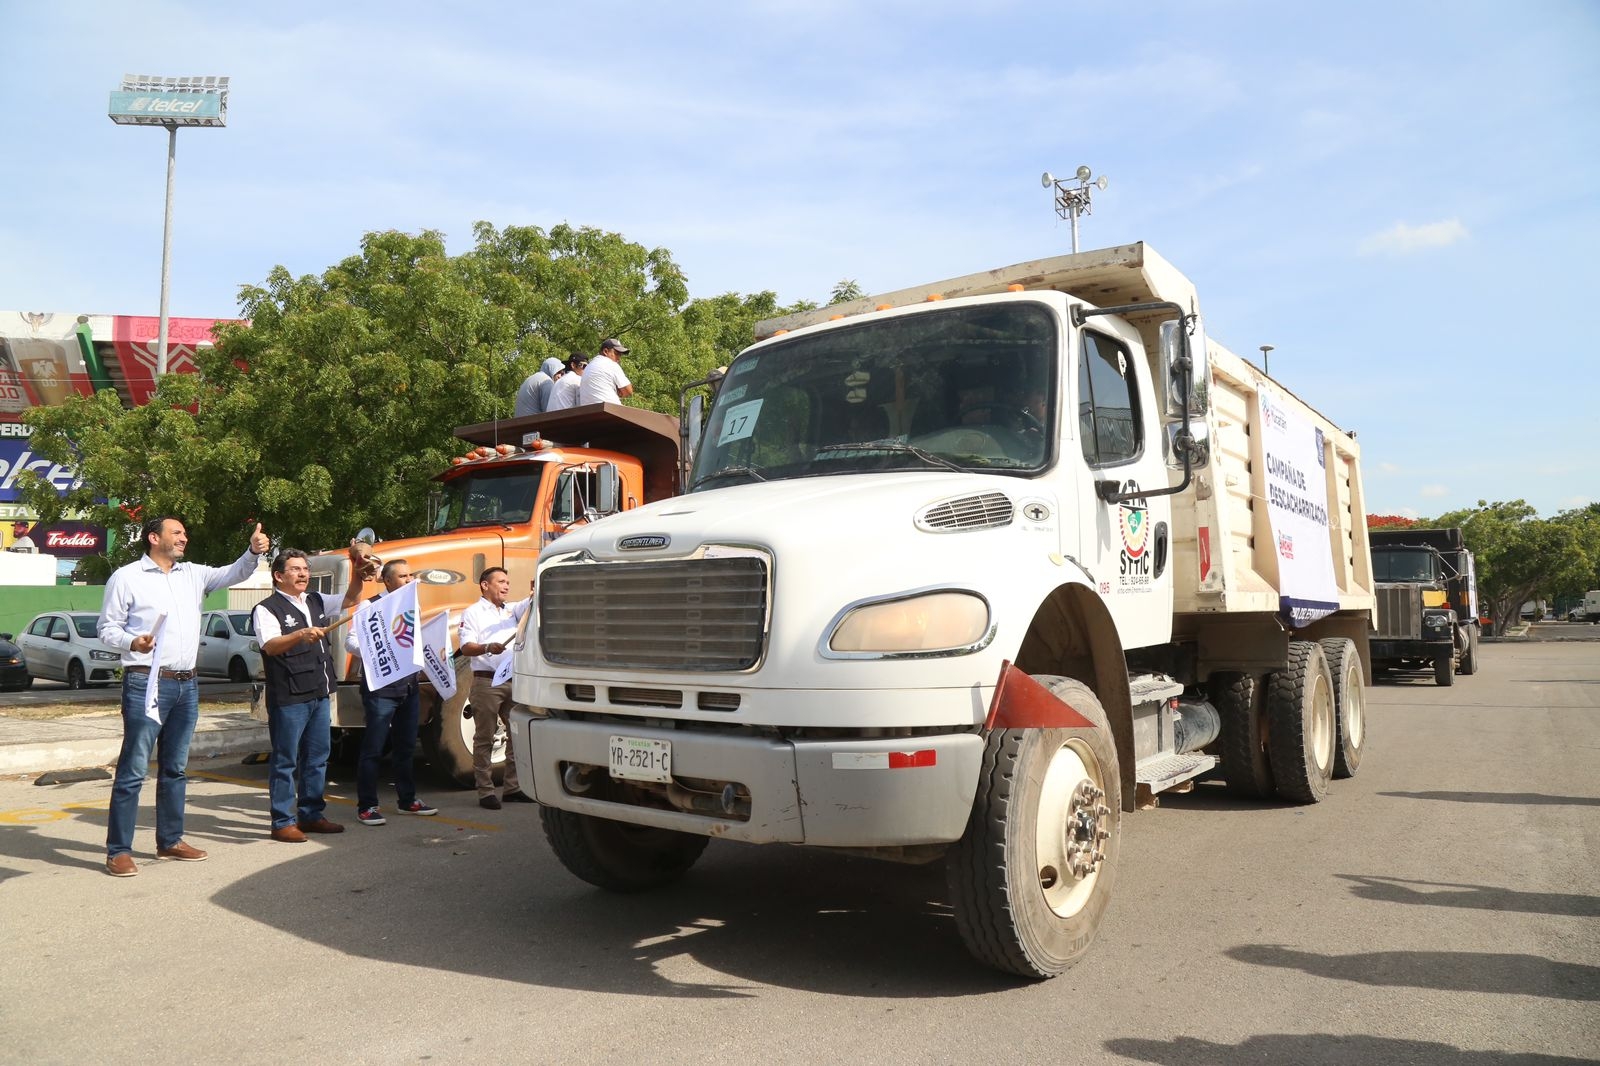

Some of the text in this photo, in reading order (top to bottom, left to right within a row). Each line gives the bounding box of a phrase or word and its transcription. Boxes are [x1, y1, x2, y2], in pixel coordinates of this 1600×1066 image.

[148, 98, 203, 113] telcel
[728, 416, 748, 436] 17
[1267, 452, 1306, 491] CAMPAÑA DE
[47, 532, 97, 546] Troddos
[1120, 549, 1149, 575] STTIC
[368, 611, 392, 677] Yucatán
[423, 646, 450, 688] Yucatán
[611, 747, 668, 771] YR-2521-C
